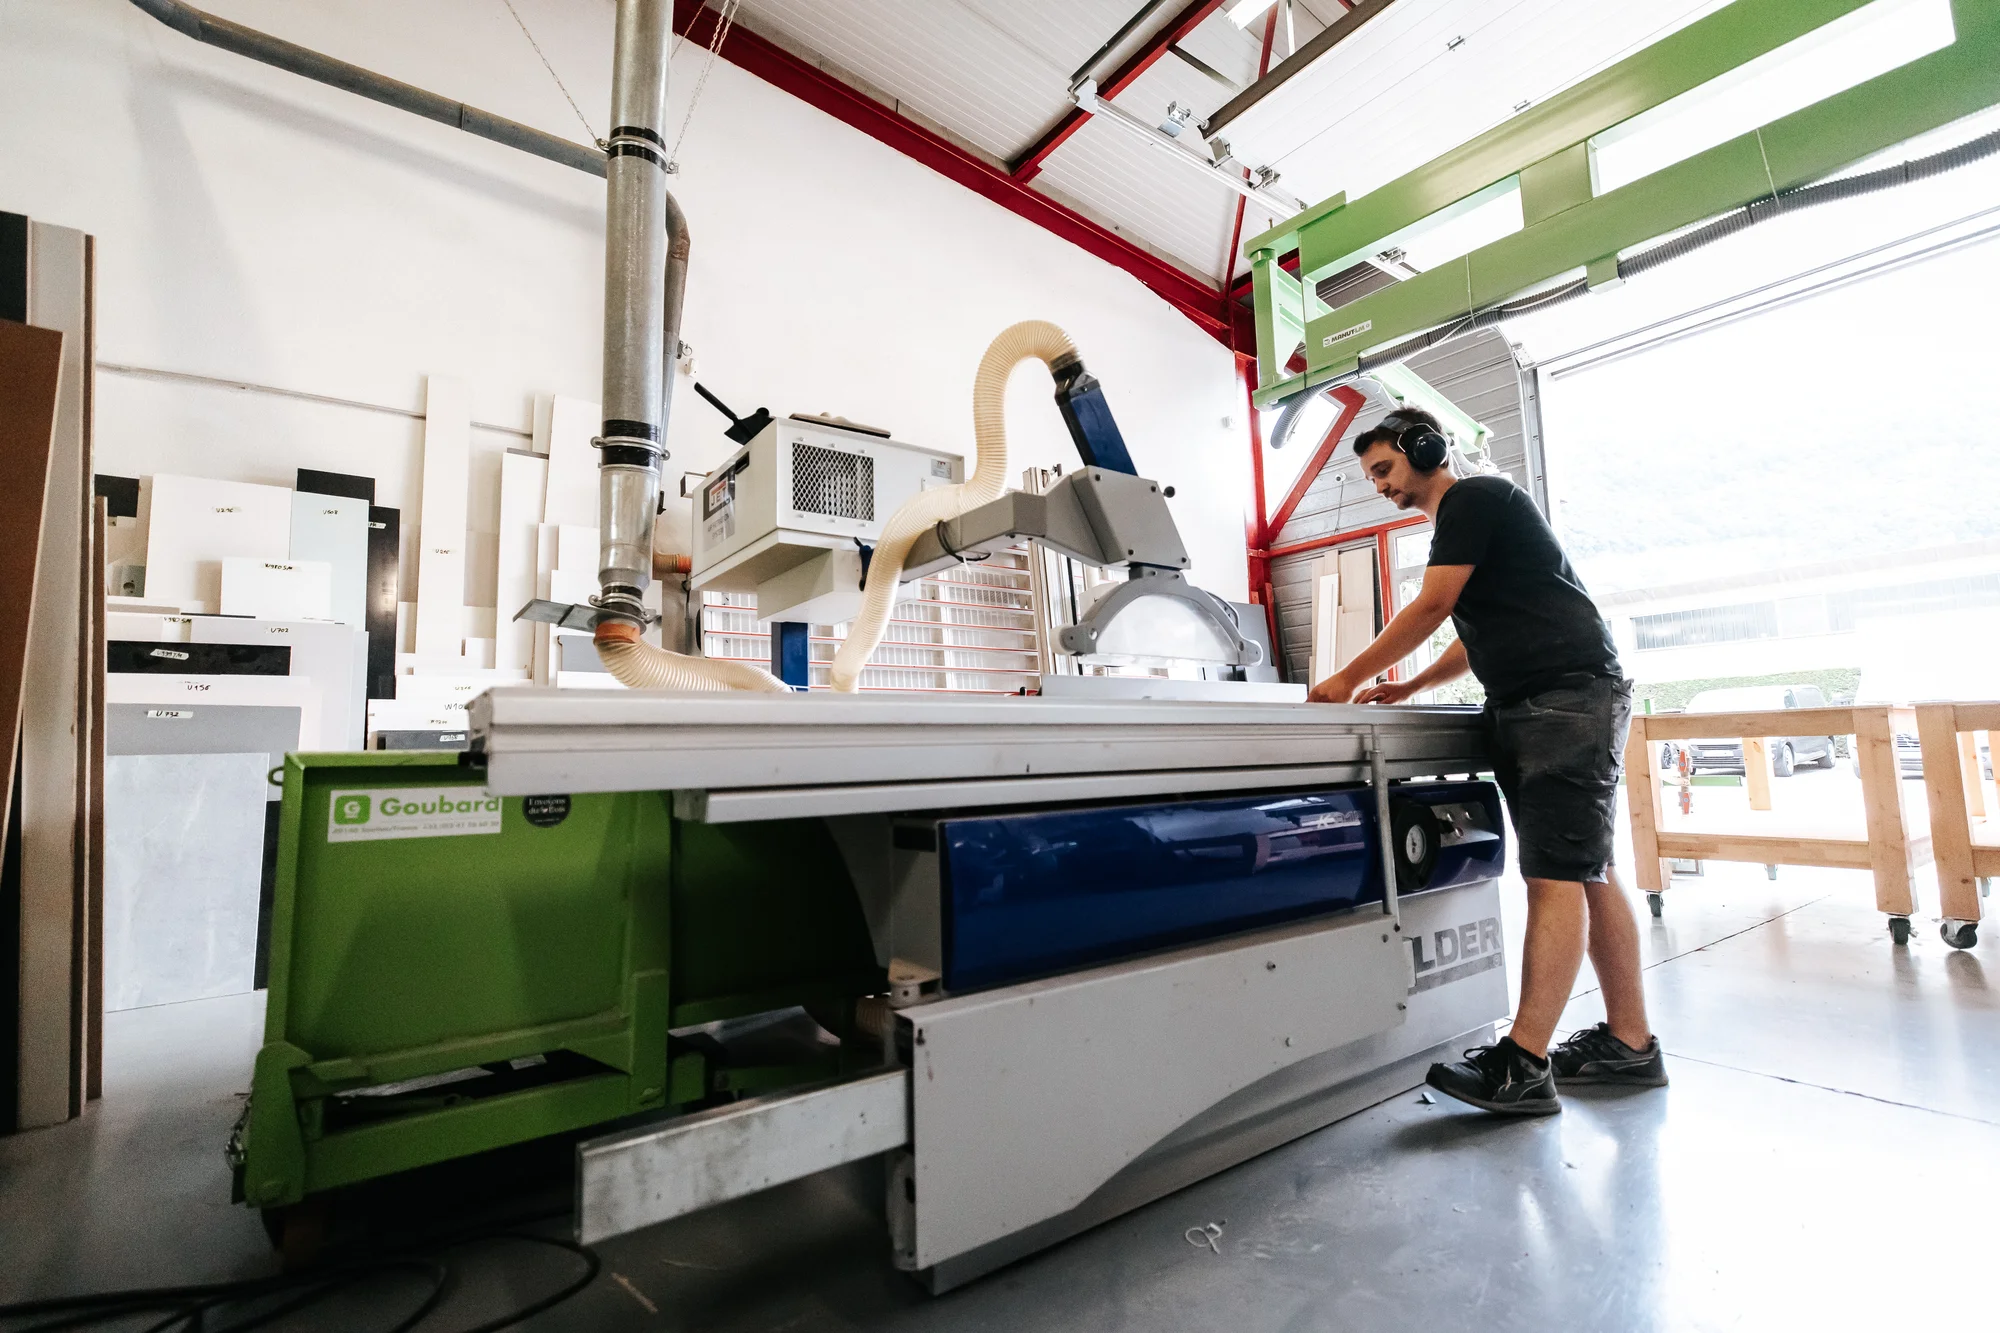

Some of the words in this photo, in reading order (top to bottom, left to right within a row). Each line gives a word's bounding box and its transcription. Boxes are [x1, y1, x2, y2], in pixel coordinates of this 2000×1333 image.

[711, 487, 726, 506] JET
[379, 795, 500, 817] Goubard
[1413, 916, 1501, 974] LDER
